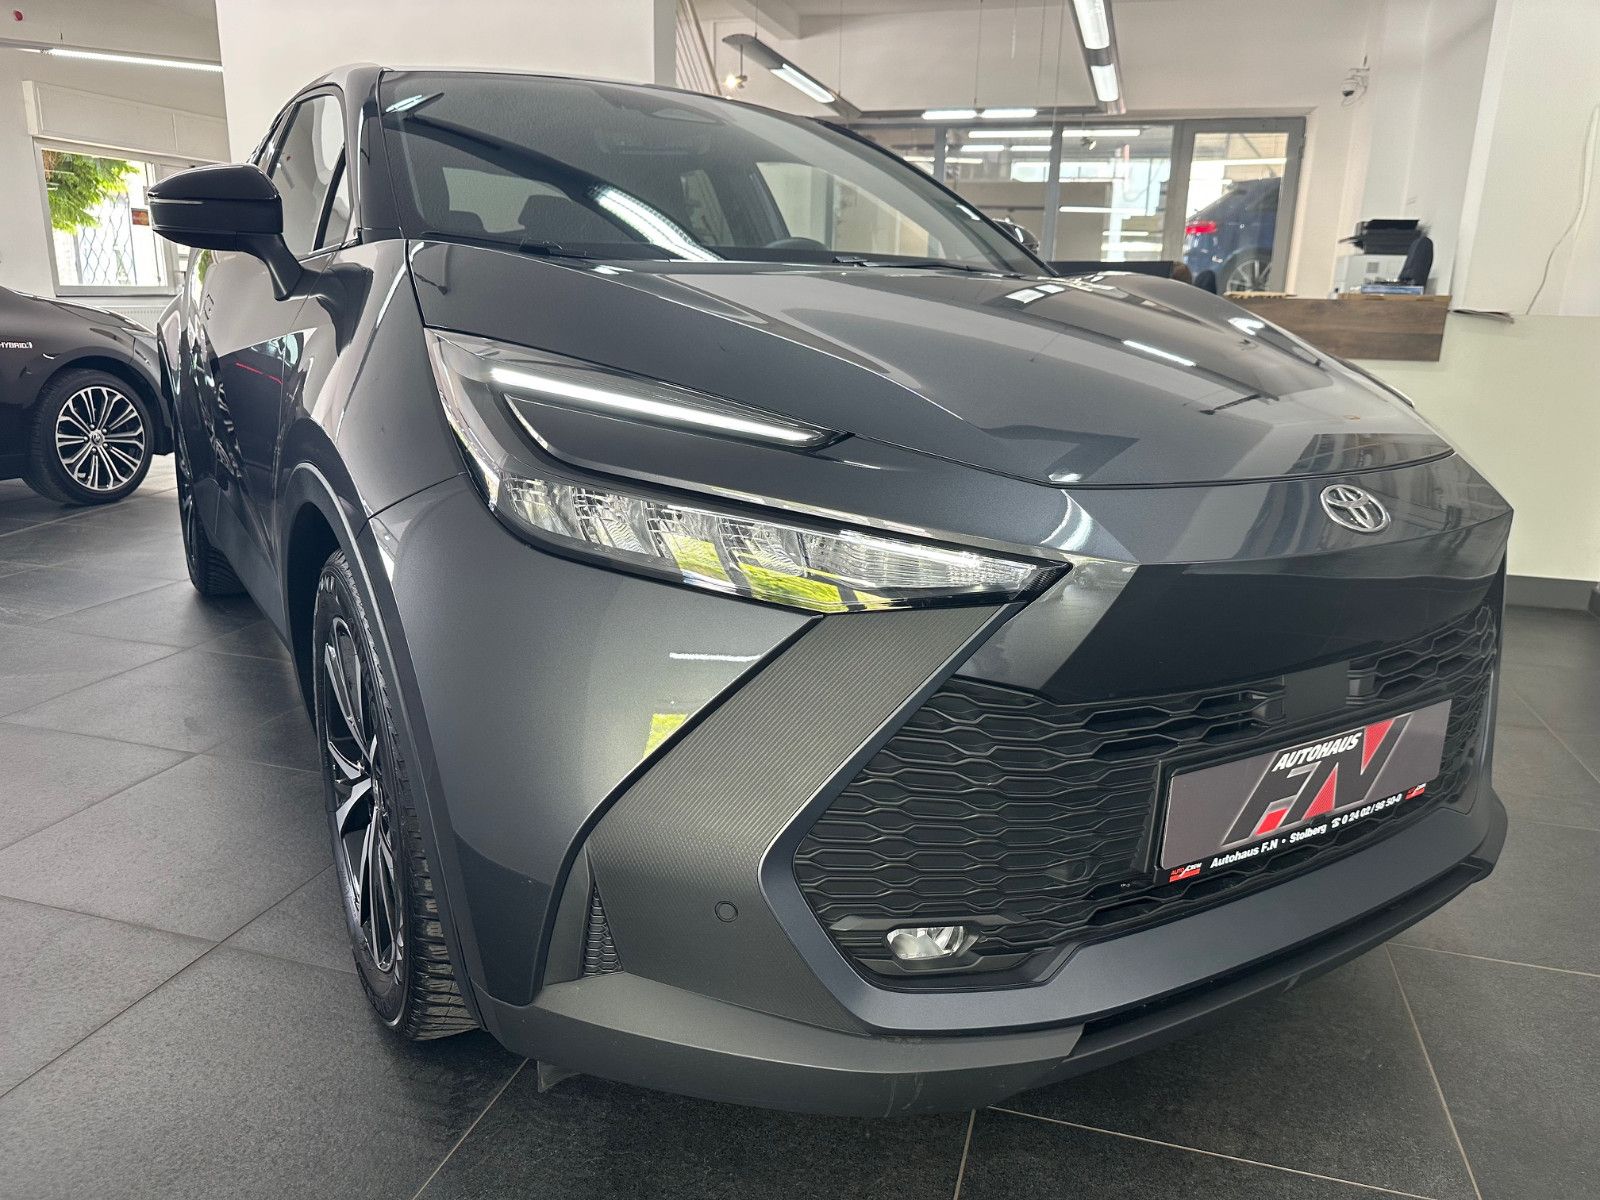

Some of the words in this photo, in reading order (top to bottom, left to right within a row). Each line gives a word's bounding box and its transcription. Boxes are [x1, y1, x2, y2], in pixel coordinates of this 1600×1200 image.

[1271, 732, 1362, 772] AUTOHAUS
[1210, 846, 1260, 869] Autohaus
[1260, 838, 1278, 853] F.N
[1289, 824, 1328, 843] Stolberg
